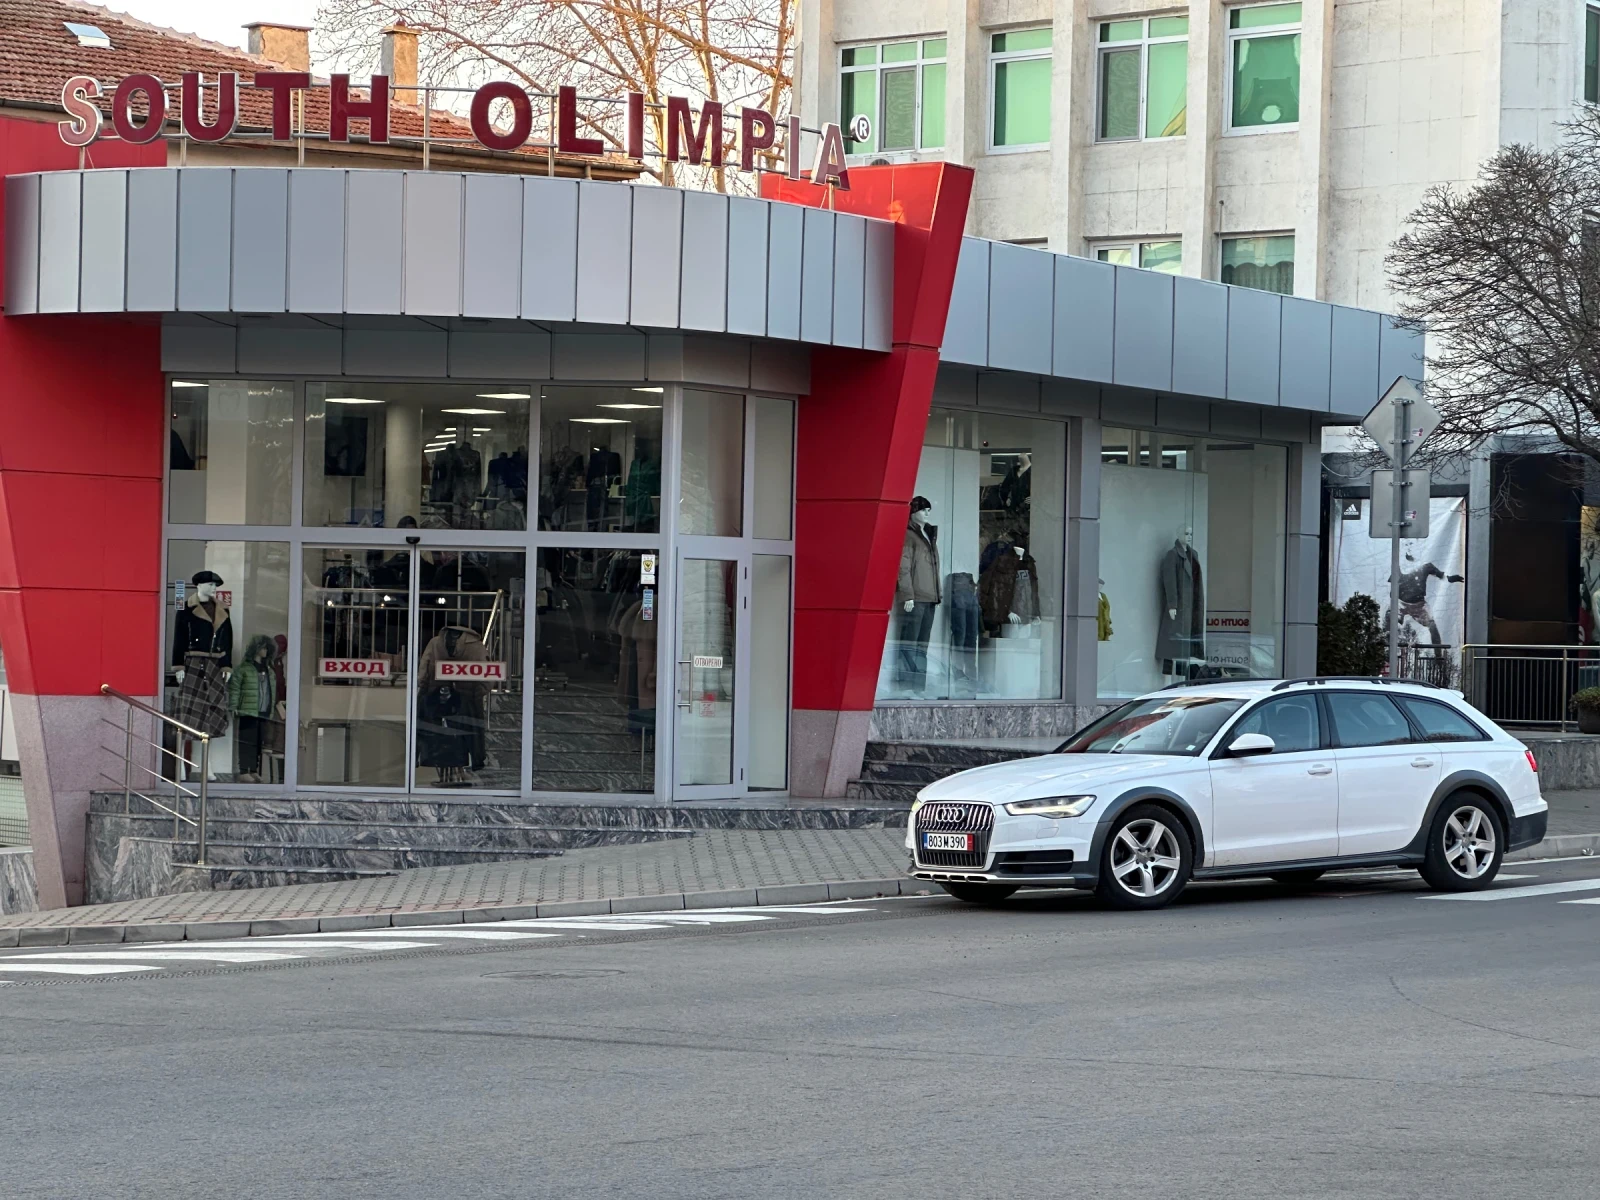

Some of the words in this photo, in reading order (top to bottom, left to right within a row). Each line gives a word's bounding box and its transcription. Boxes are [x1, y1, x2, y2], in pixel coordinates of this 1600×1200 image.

[58, 71, 390, 146] SOUTH
[324, 661, 385, 675] ВХОД
[441, 663, 502, 678] ВХОД
